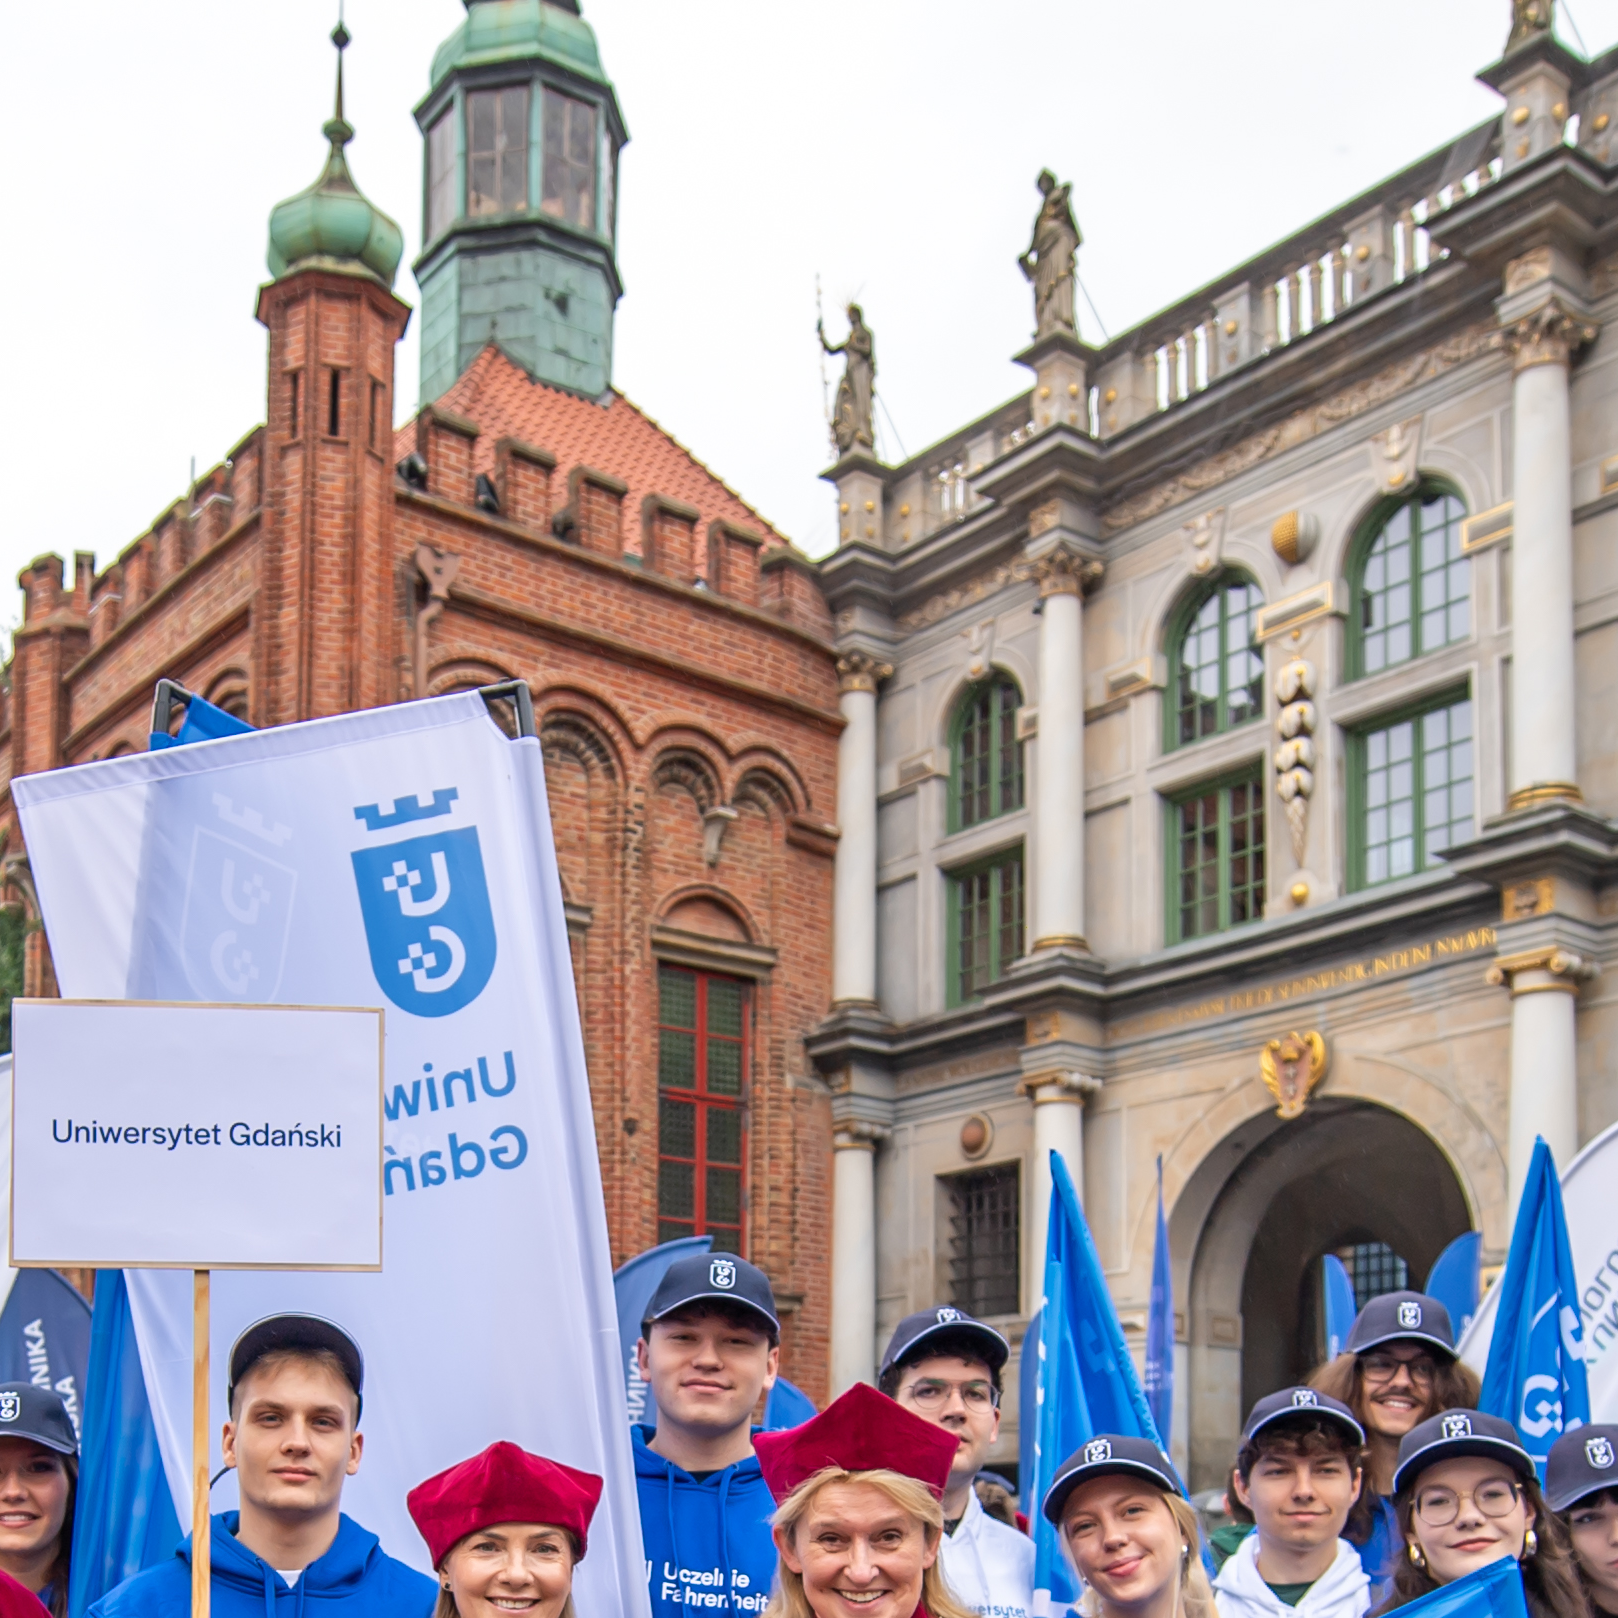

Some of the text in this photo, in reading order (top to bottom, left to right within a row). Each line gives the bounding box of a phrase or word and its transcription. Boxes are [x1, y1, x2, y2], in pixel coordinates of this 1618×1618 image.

[52, 1119, 342, 1151] Uniwersytet Gdański
[662, 1581, 769, 1612] Fahrenheit
